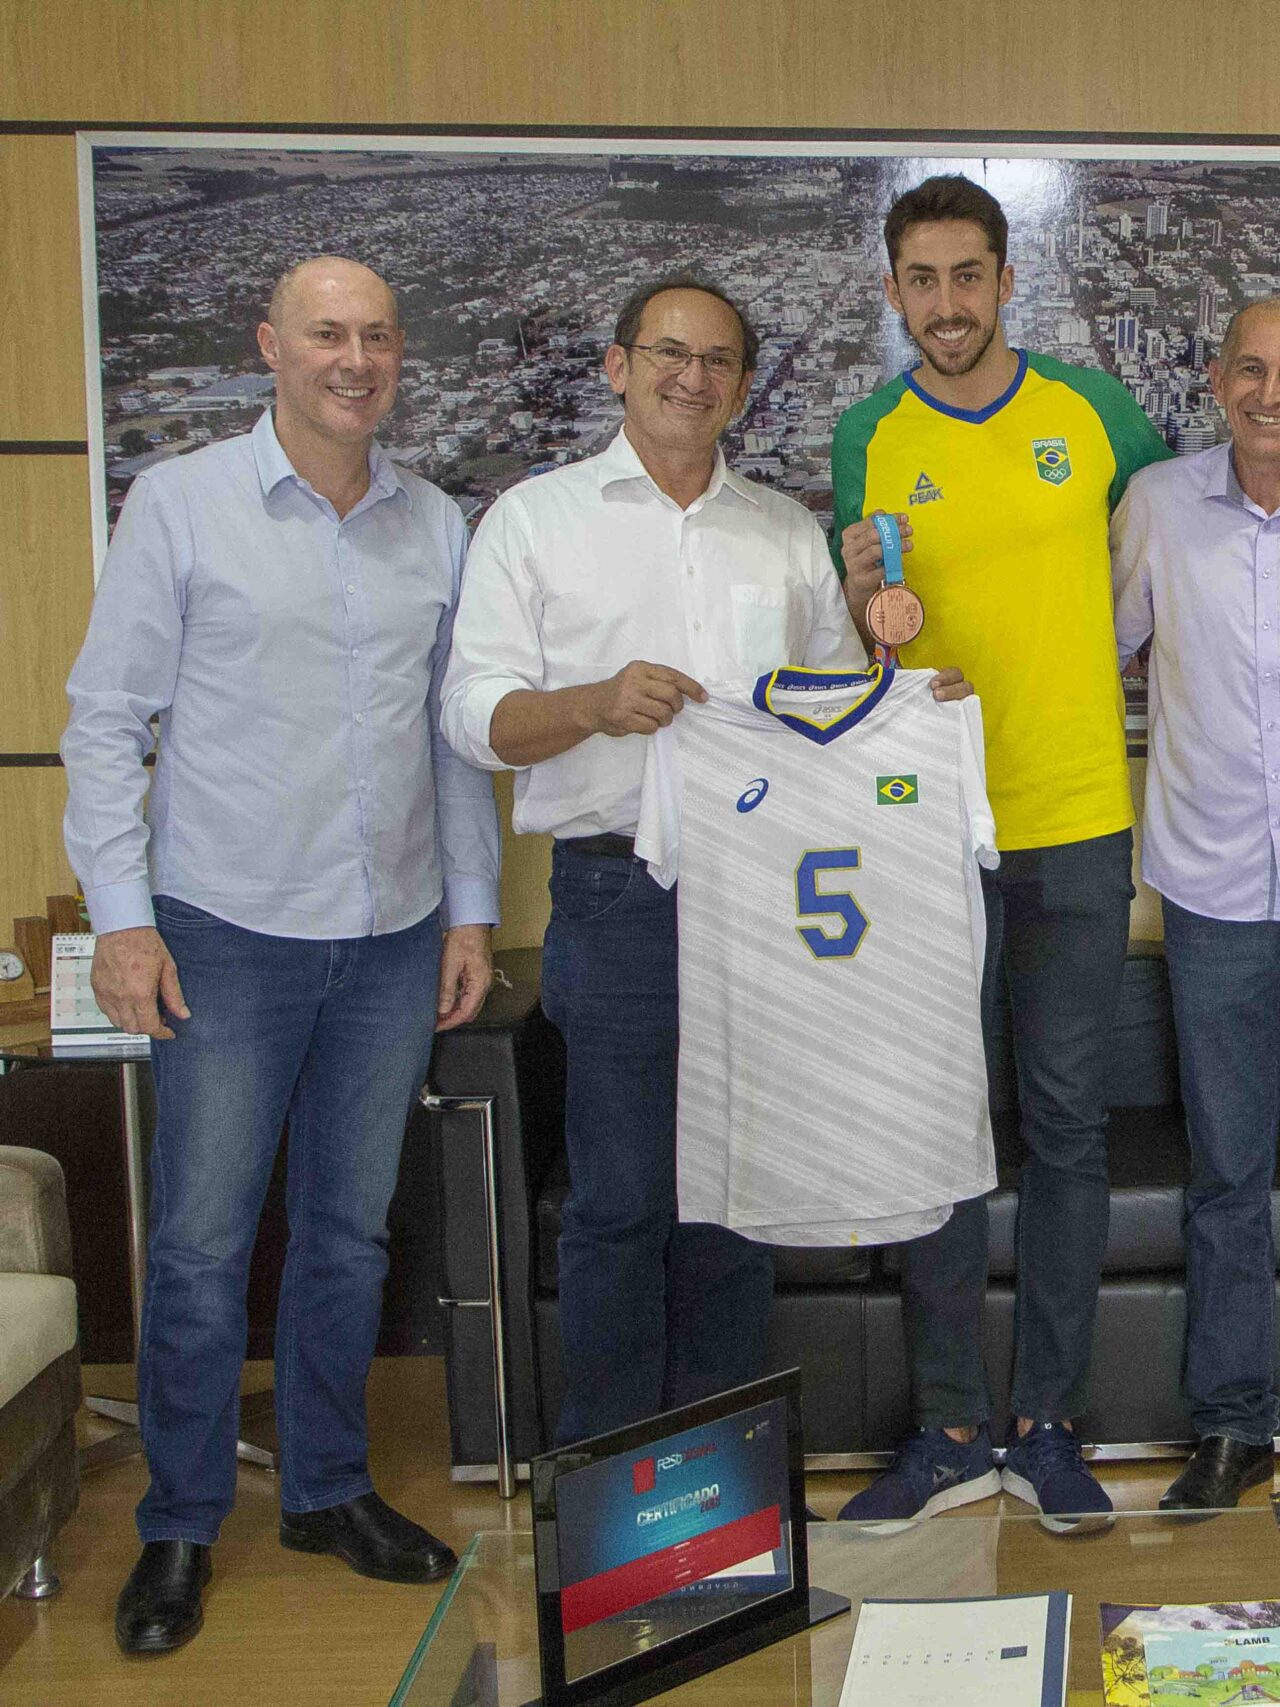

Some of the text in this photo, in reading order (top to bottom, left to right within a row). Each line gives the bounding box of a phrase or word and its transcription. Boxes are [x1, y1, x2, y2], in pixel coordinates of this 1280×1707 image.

[1032, 439, 1065, 449] BRASIL
[908, 486, 944, 506] PEAK
[794, 845, 872, 961] 5
[637, 1483, 720, 1527] CERTIFICADO
[1235, 1636, 1271, 1646] LAMB
